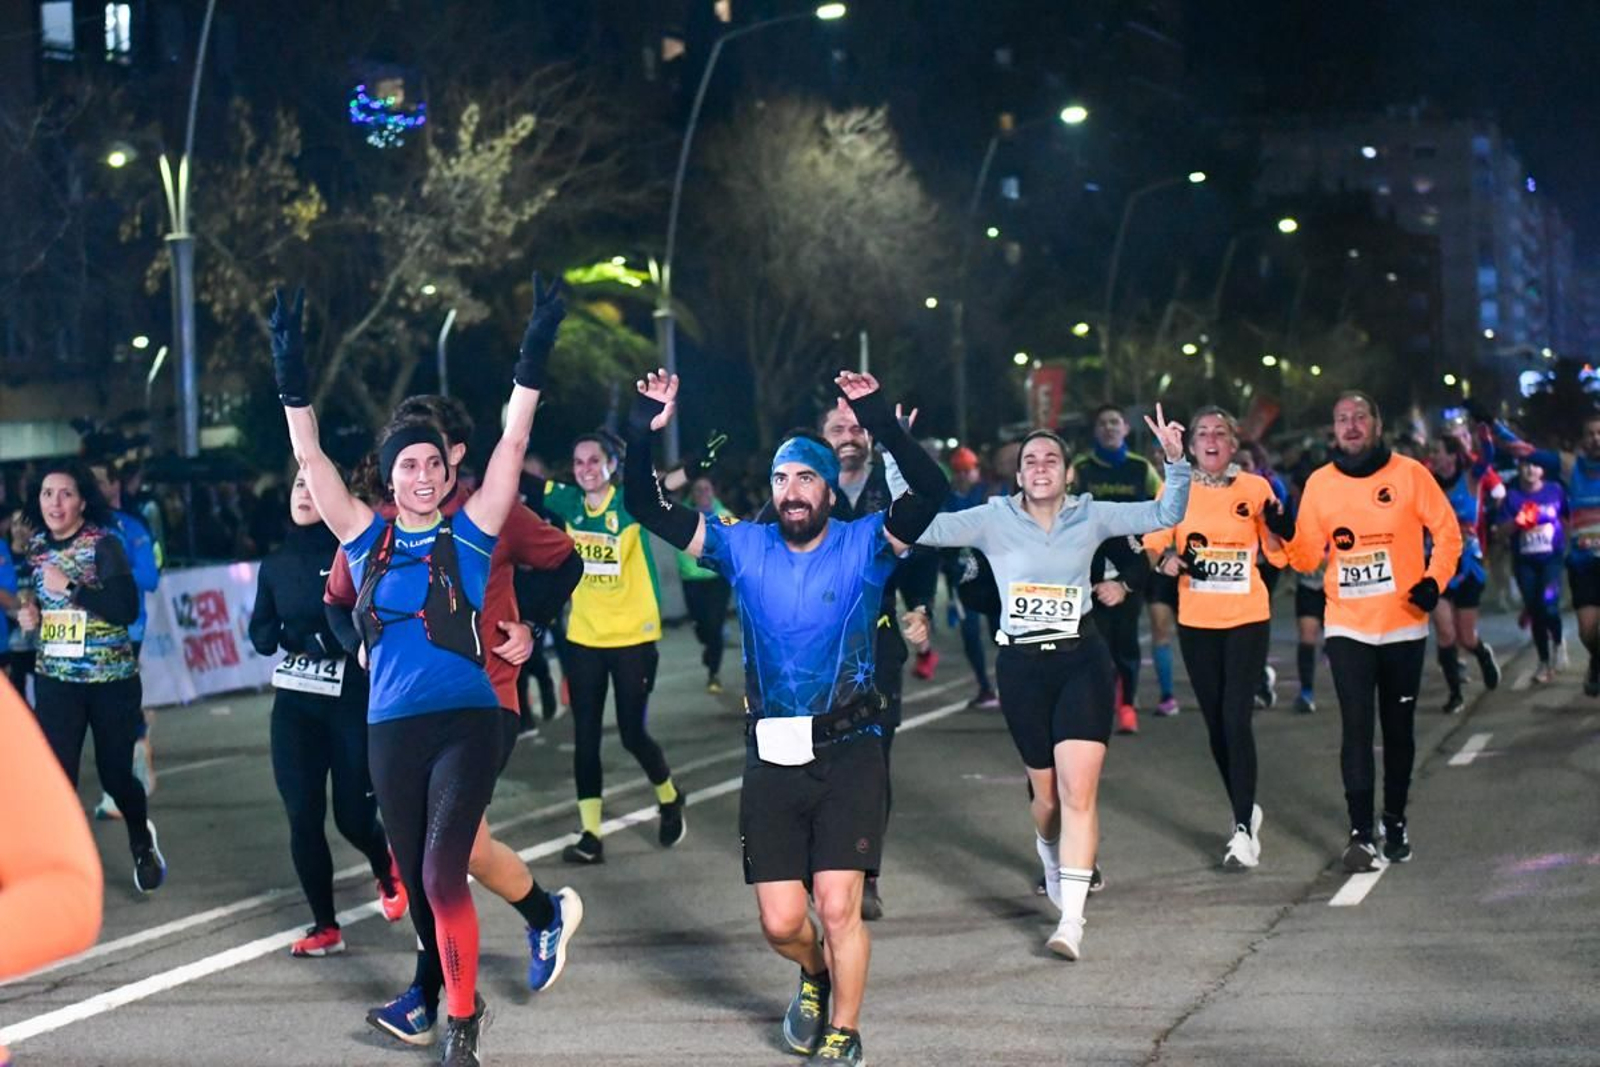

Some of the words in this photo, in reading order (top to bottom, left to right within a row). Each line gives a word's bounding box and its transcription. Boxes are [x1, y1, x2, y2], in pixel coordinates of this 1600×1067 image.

[575, 543, 615, 560] 3182
[1203, 560, 1245, 577] 022
[1341, 562, 1386, 583] 7917
[1014, 596, 1074, 618] 9239
[282, 653, 338, 678] 9914
